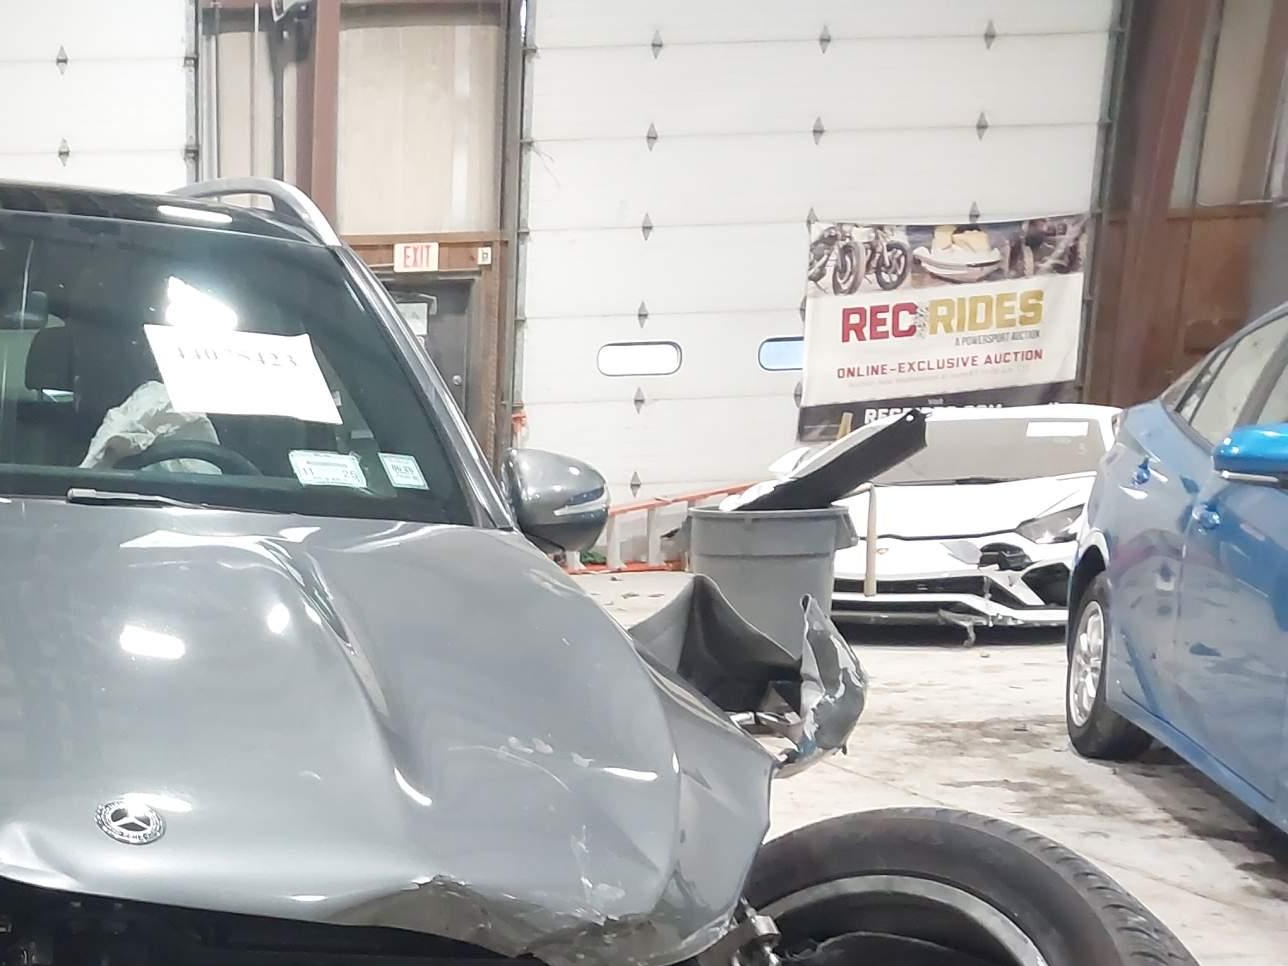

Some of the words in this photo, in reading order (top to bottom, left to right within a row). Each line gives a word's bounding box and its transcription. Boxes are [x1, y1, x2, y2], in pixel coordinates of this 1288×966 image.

[403, 245, 431, 268] EXIT
[841, 303, 918, 343] REC
[928, 289, 1043, 335] RIDES
[837, 355, 979, 379] ONLINE-EXCLUSIVE
[983, 349, 1043, 366] AUCTION
